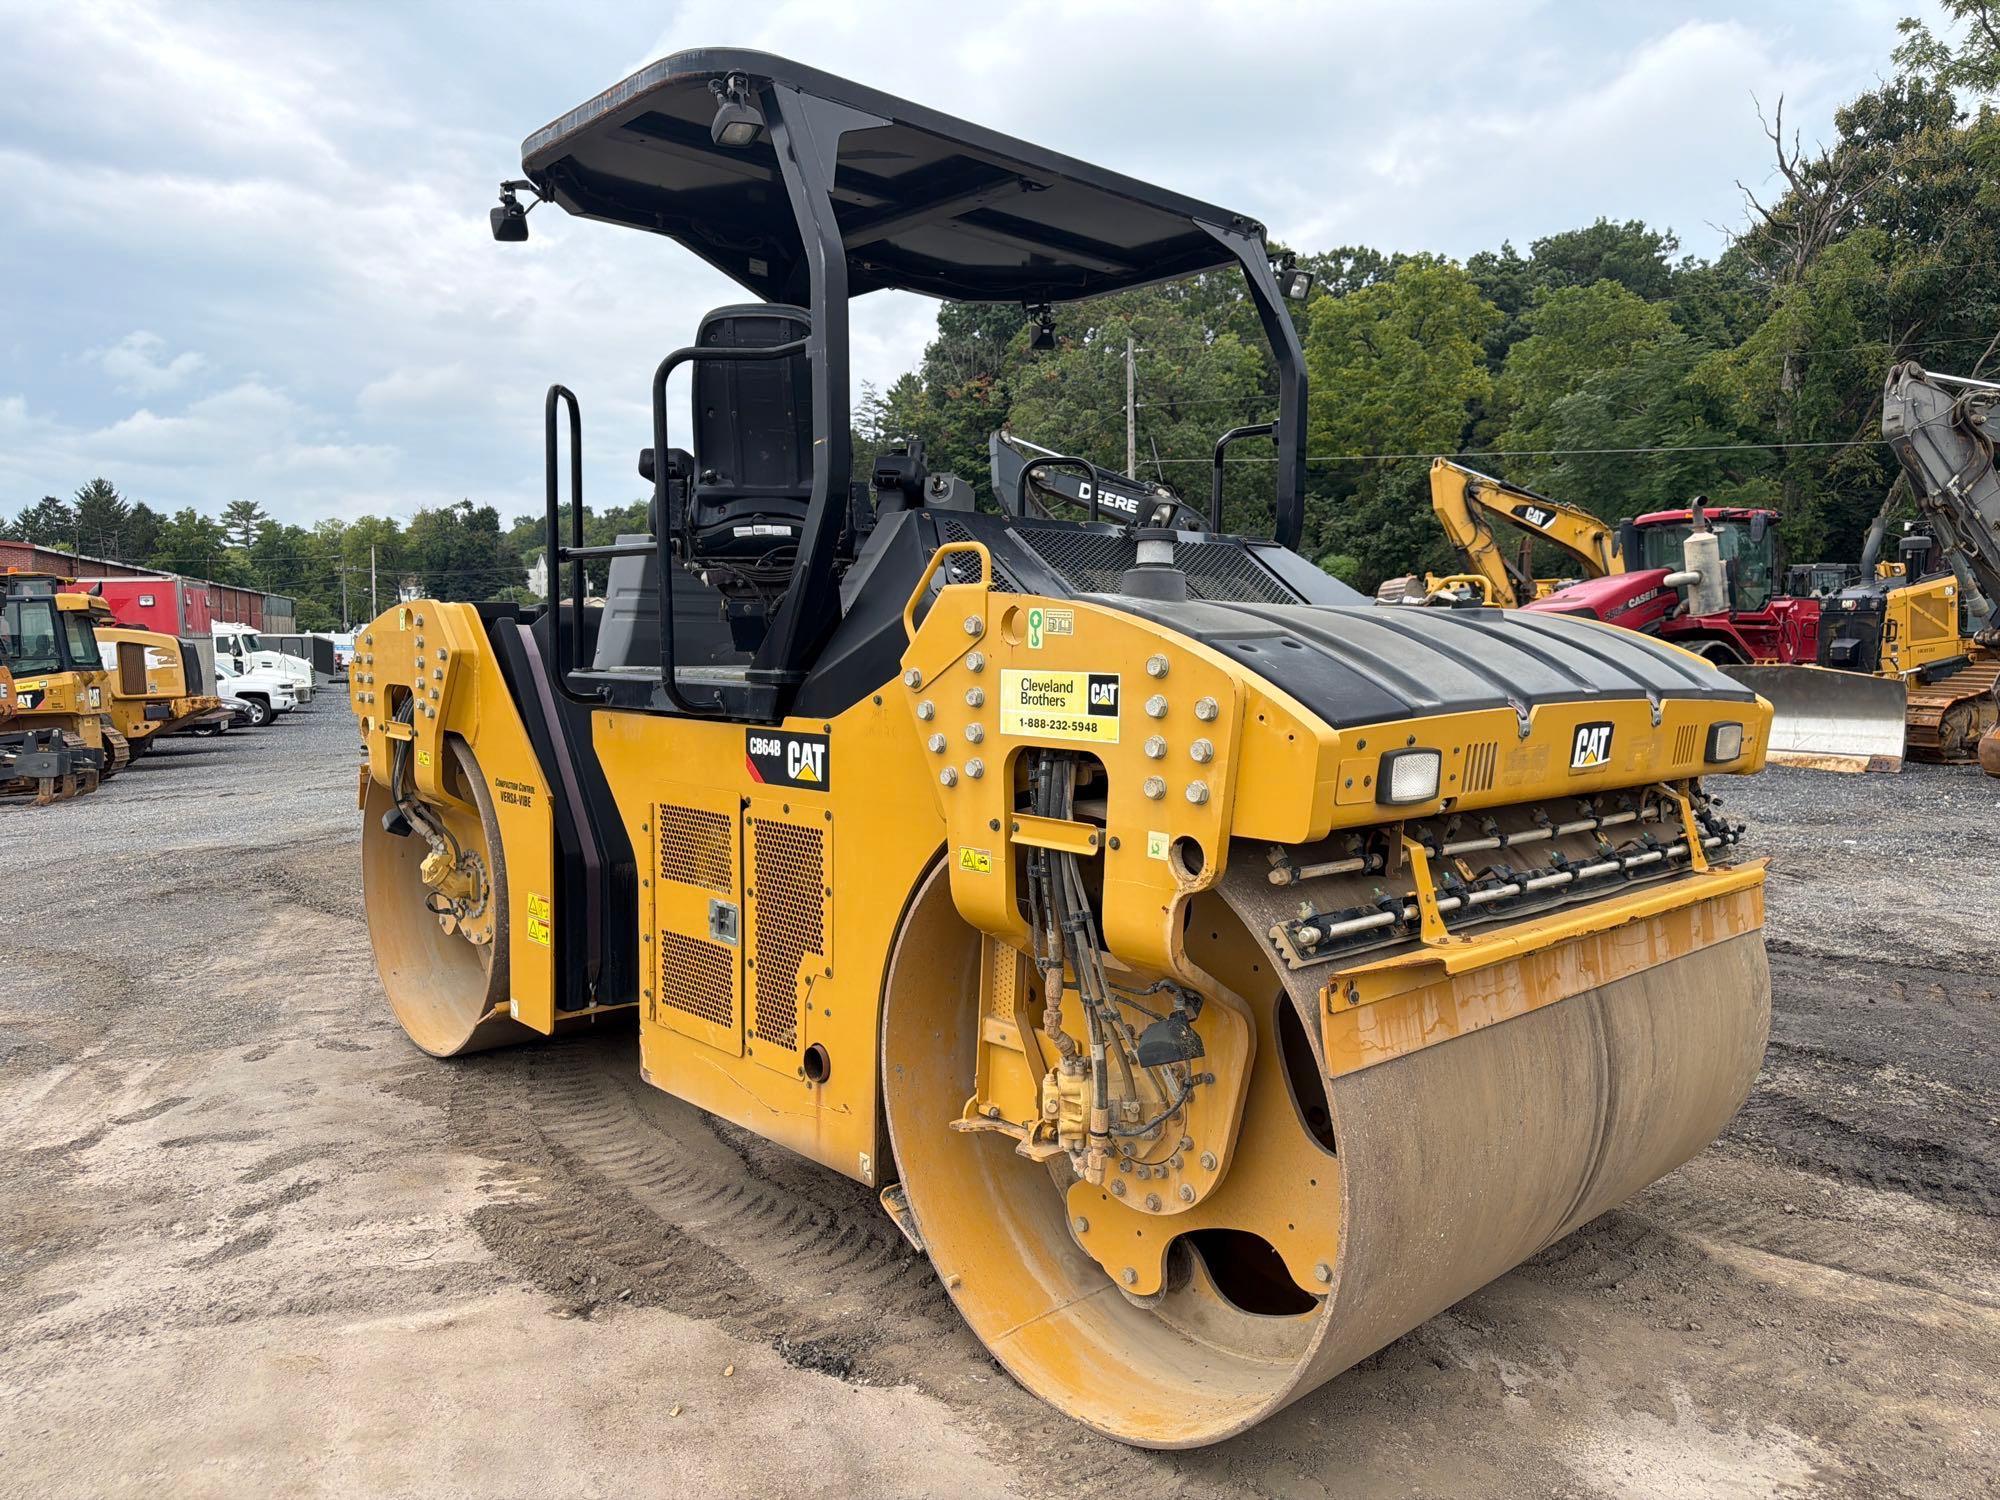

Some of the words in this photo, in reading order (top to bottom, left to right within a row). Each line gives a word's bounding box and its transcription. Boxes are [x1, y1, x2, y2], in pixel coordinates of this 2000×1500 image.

[1078, 482, 1139, 514] DEERE
[1525, 506, 1547, 526] CAT
[1628, 591, 1651, 608] CASE
[1020, 678, 1074, 694] Cleveland
[1090, 683, 1118, 706] CAT
[17, 694, 33, 709] AT
[88, 688, 100, 708] CAT
[1020, 691, 1066, 708] Brothers
[1019, 718, 1098, 733] 1-888-232-5948
[1573, 727, 1611, 766] CAT
[749, 737, 781, 757] CB64B
[787, 740, 825, 782] CAT
[500, 791, 531, 808] VERSA-VIBE
